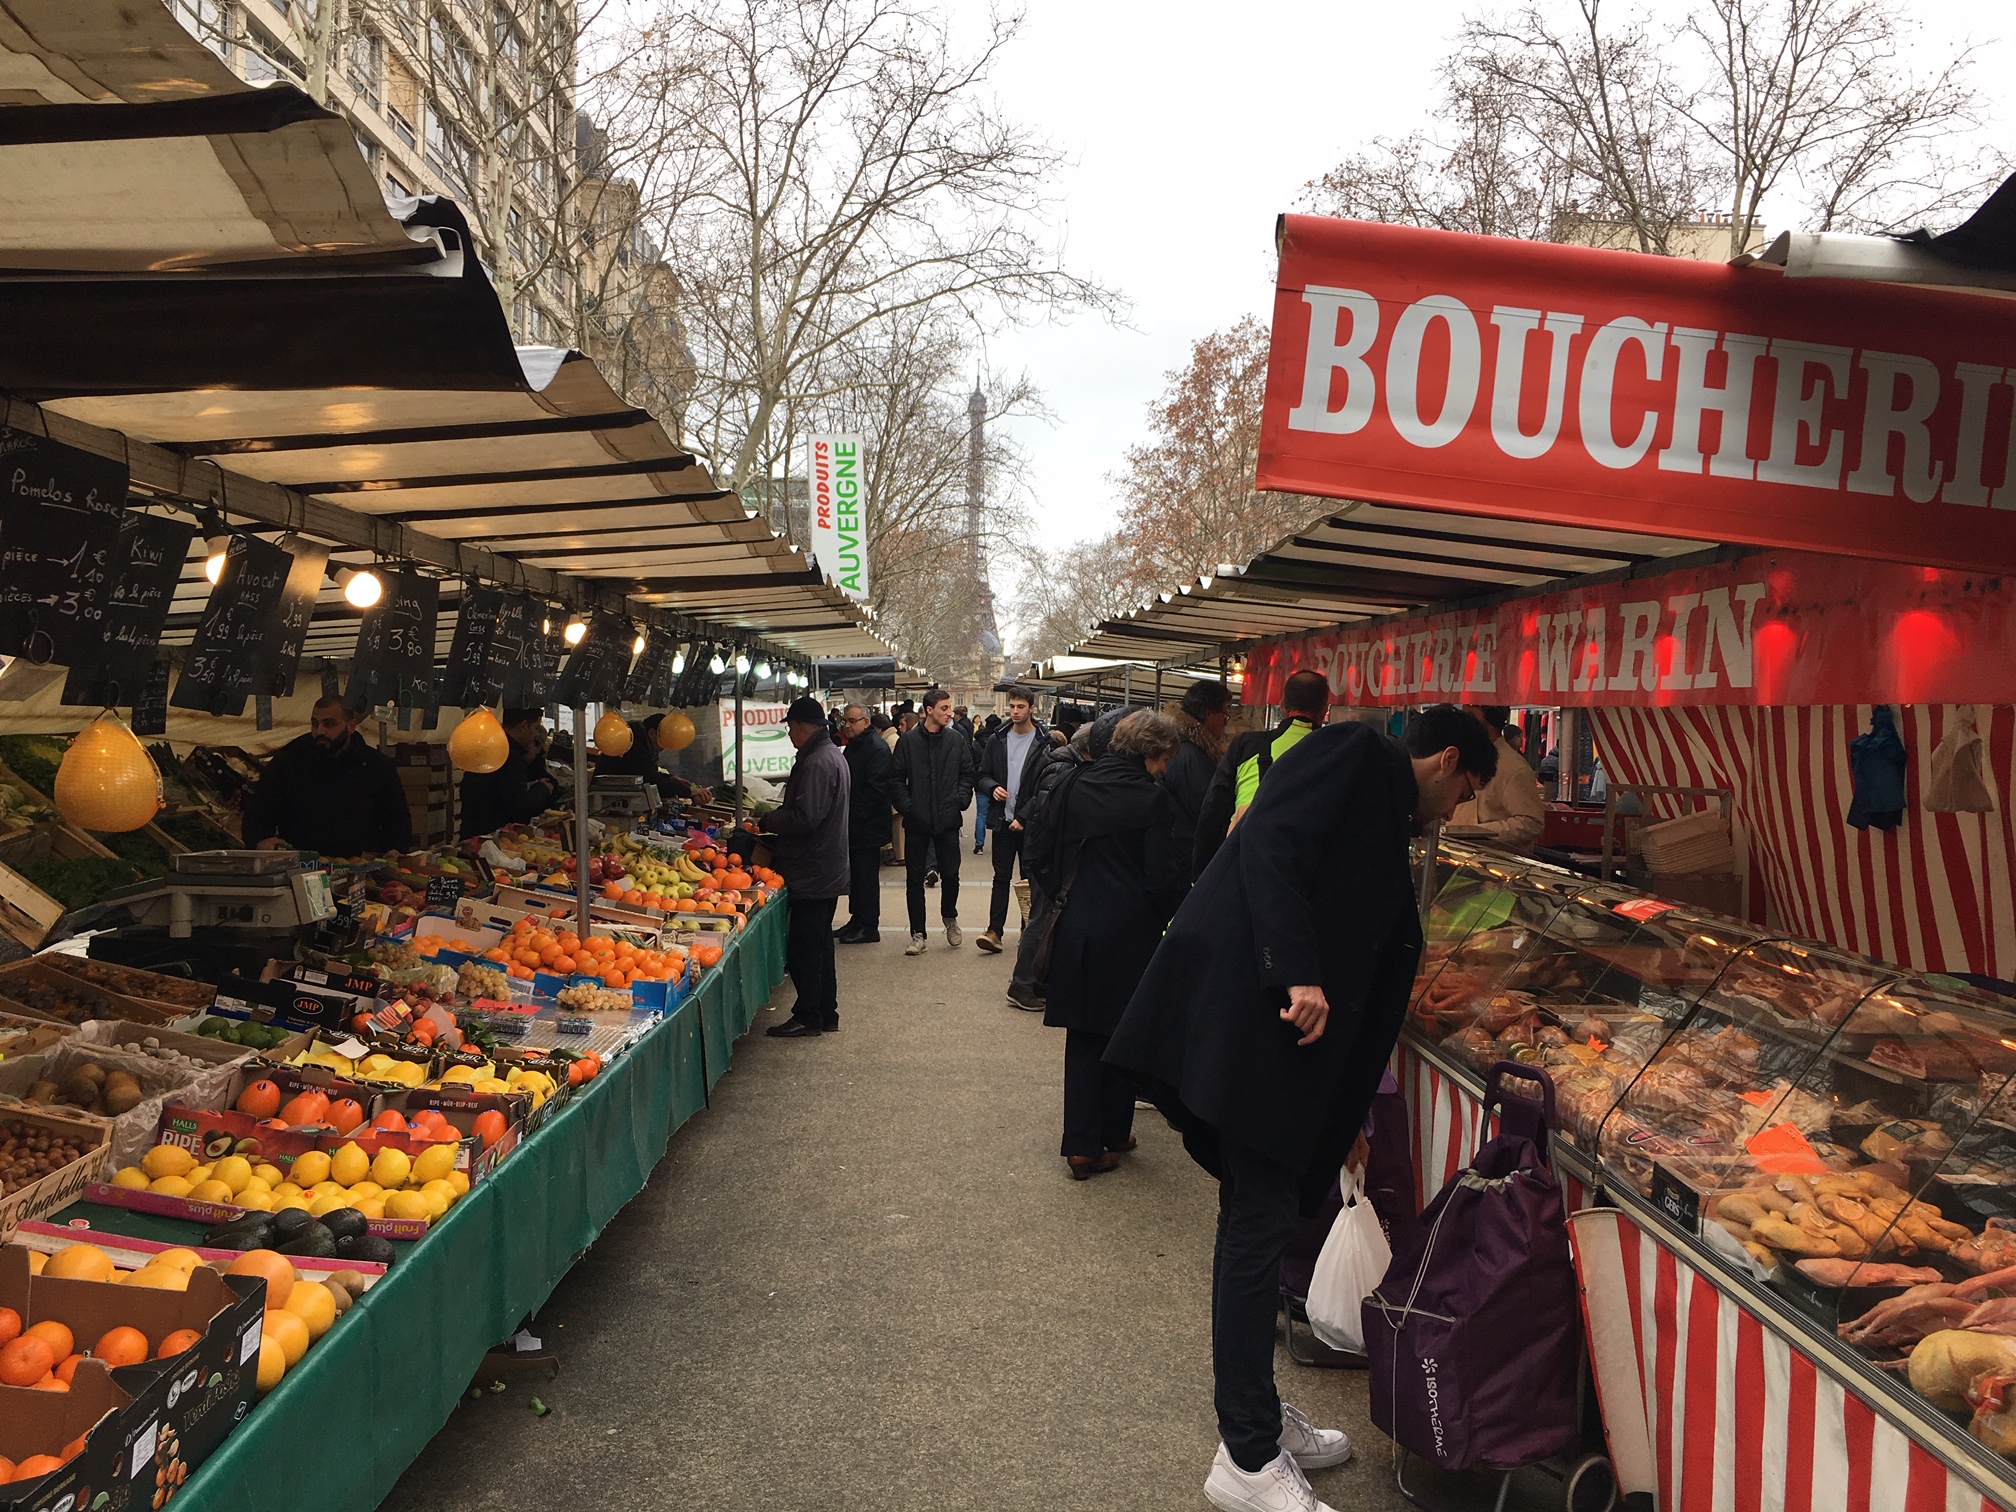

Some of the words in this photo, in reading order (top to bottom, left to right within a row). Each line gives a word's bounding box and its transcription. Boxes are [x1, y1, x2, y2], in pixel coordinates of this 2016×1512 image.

[1287, 284, 2016, 512] BOUCHERI
[11, 467, 73, 503] Pomelos
[815, 441, 831, 530] PRODUITS
[834, 441, 861, 592] AUVERGNE
[130, 535, 165, 563] Kiwi
[236, 560, 280, 589] Avocat
[1536, 582, 1767, 693] WARIN
[344, 978, 373, 993] JMP
[297, 1001, 320, 1013] JMP
[172, 1117, 198, 1130] HALLS
[161, 1130, 202, 1156] RIPE
[188, 1203, 213, 1216] plus
[1664, 1196, 1680, 1217] GERS
[369, 1221, 394, 1233] plus
[1425, 1376, 1448, 1458] ISOTHERME
